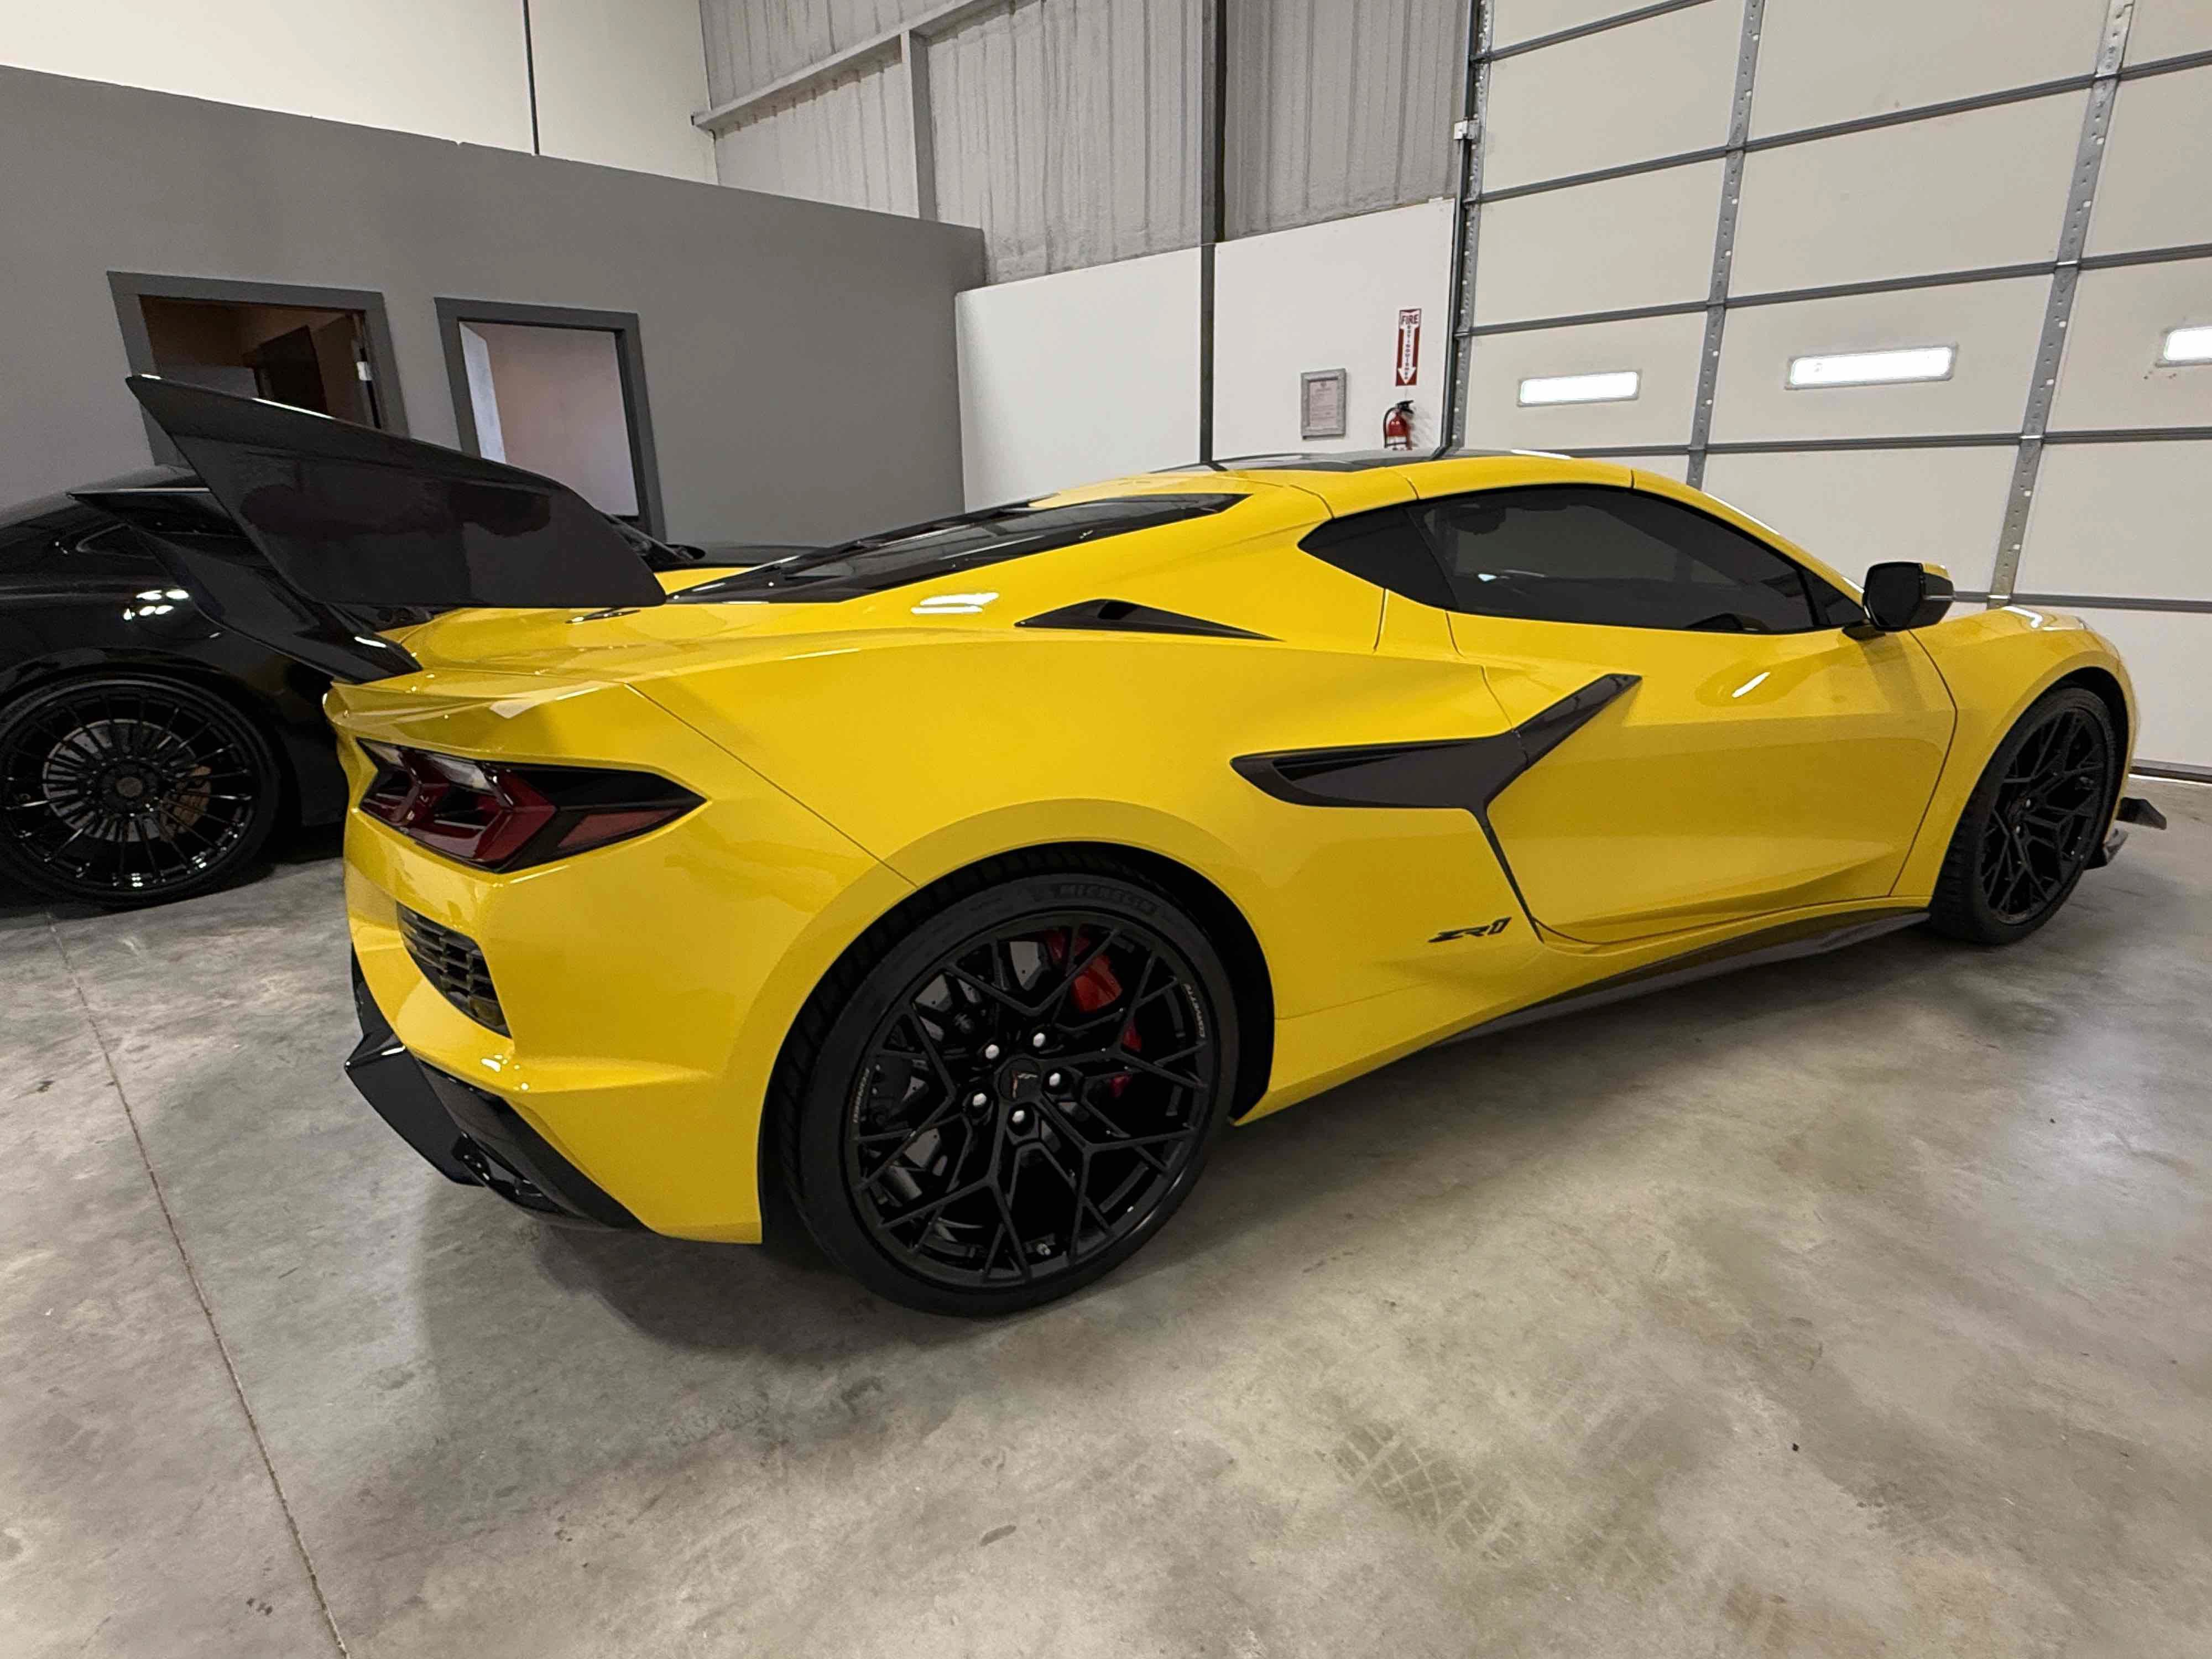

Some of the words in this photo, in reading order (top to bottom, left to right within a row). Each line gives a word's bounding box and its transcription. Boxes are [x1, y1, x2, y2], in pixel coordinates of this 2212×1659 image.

[1402, 315, 1419, 325] FIRE
[1055, 884, 1157, 912] MICHELIN
[1427, 916, 1512, 942] ZR1
